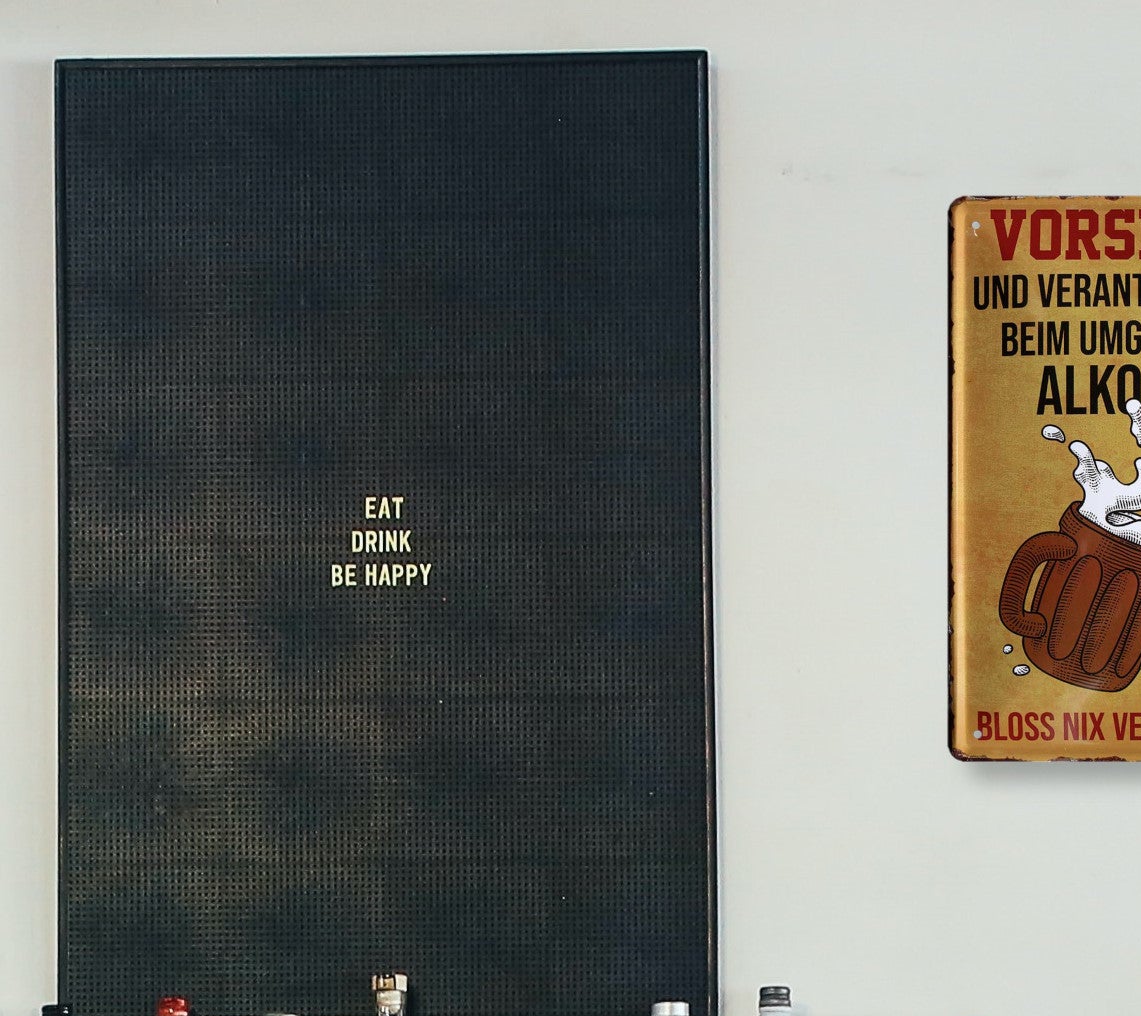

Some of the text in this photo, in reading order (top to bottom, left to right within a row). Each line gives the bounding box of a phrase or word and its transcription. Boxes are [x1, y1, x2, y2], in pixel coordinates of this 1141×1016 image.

[973, 273, 1029, 309] UND
[1001, 321, 1069, 357] BEIM
[365, 497, 404, 519] EAT
[351, 530, 412, 553] DRINK
[331, 563, 432, 587] BE HAPPY
[977, 711, 1055, 742] BLOSS
[1063, 712, 1105, 742] NIX
